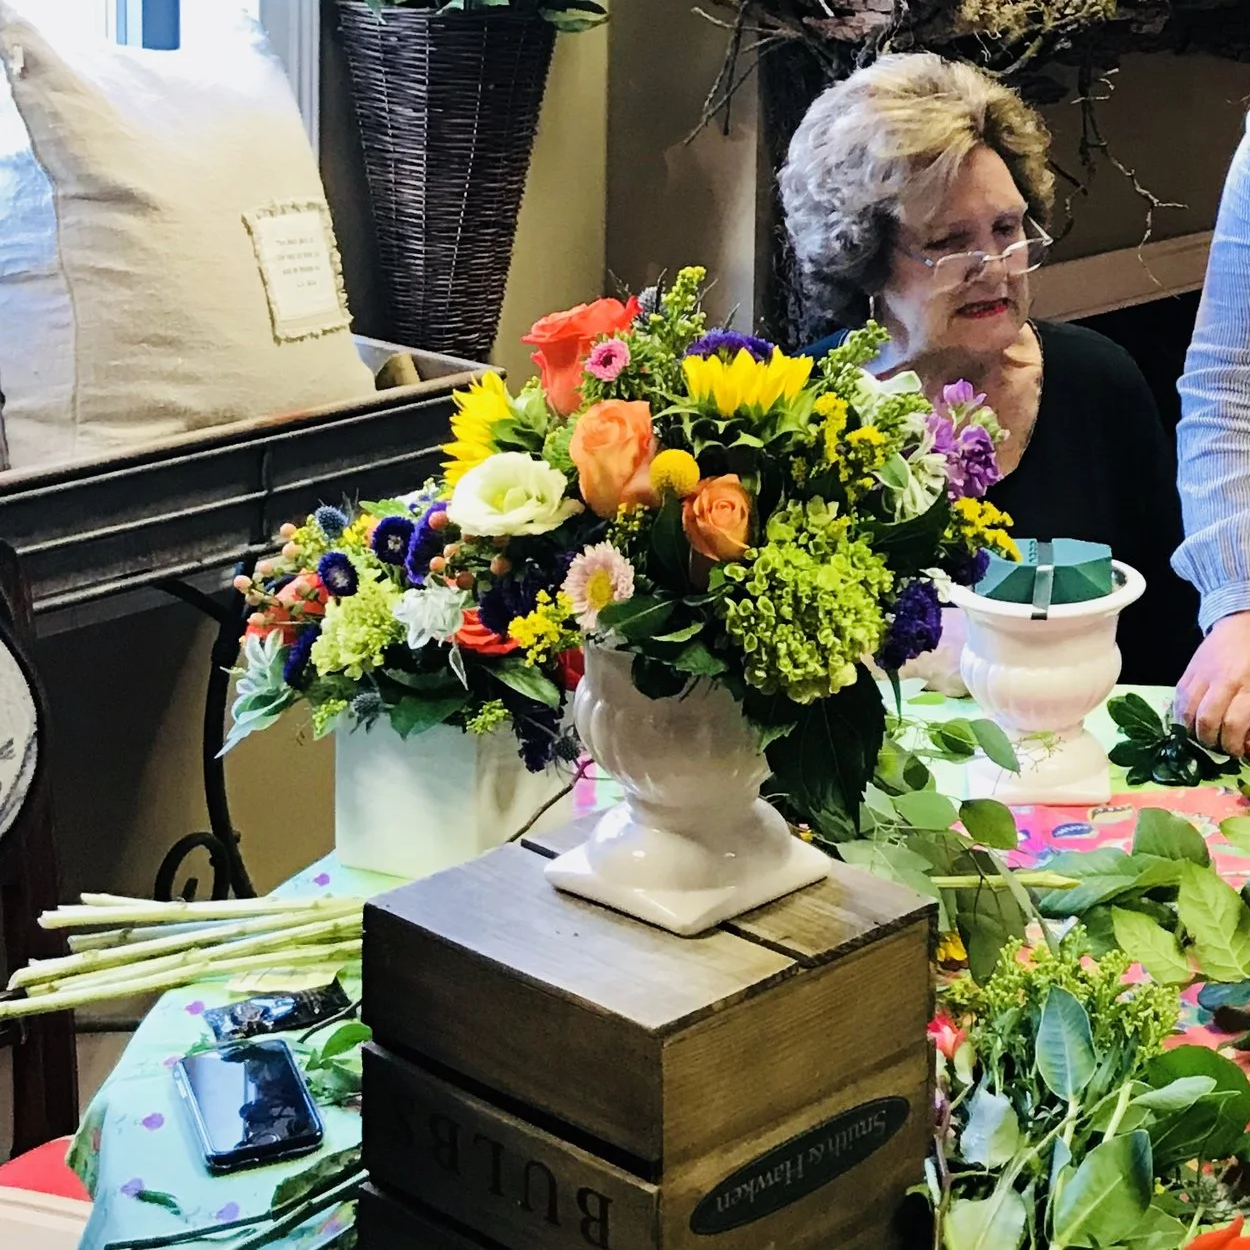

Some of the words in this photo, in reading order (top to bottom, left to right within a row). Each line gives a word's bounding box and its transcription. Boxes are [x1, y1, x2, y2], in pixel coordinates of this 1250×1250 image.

[809, 1144, 825, 1164] &
[828, 1109, 887, 1157] Smith
[716, 1156, 806, 1213] Hawken
